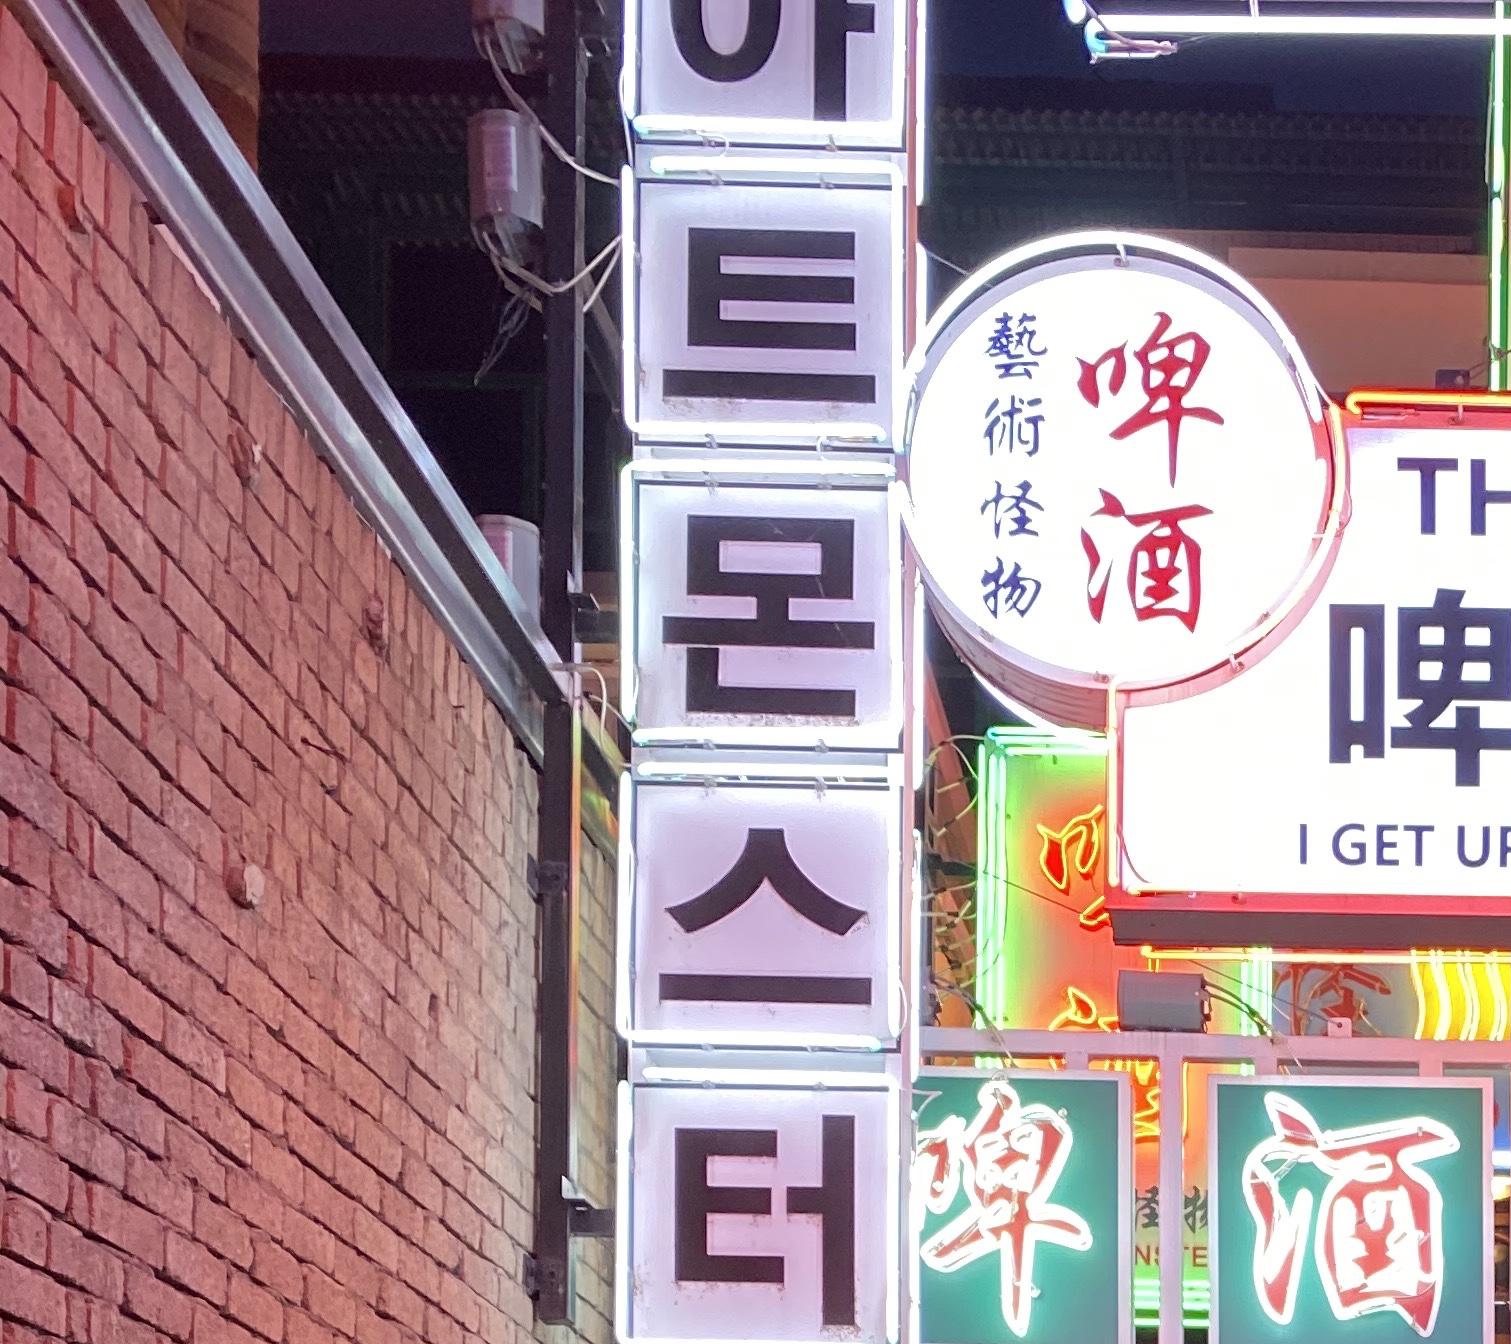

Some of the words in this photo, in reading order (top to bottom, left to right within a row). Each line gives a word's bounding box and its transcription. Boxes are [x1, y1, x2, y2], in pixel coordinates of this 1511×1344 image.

[980, 312, 1048, 620] 藝術怪物
[1076, 311, 1226, 634] 啤酒
[1299, 824, 1308, 864] I
[1332, 822, 1434, 867] GET
